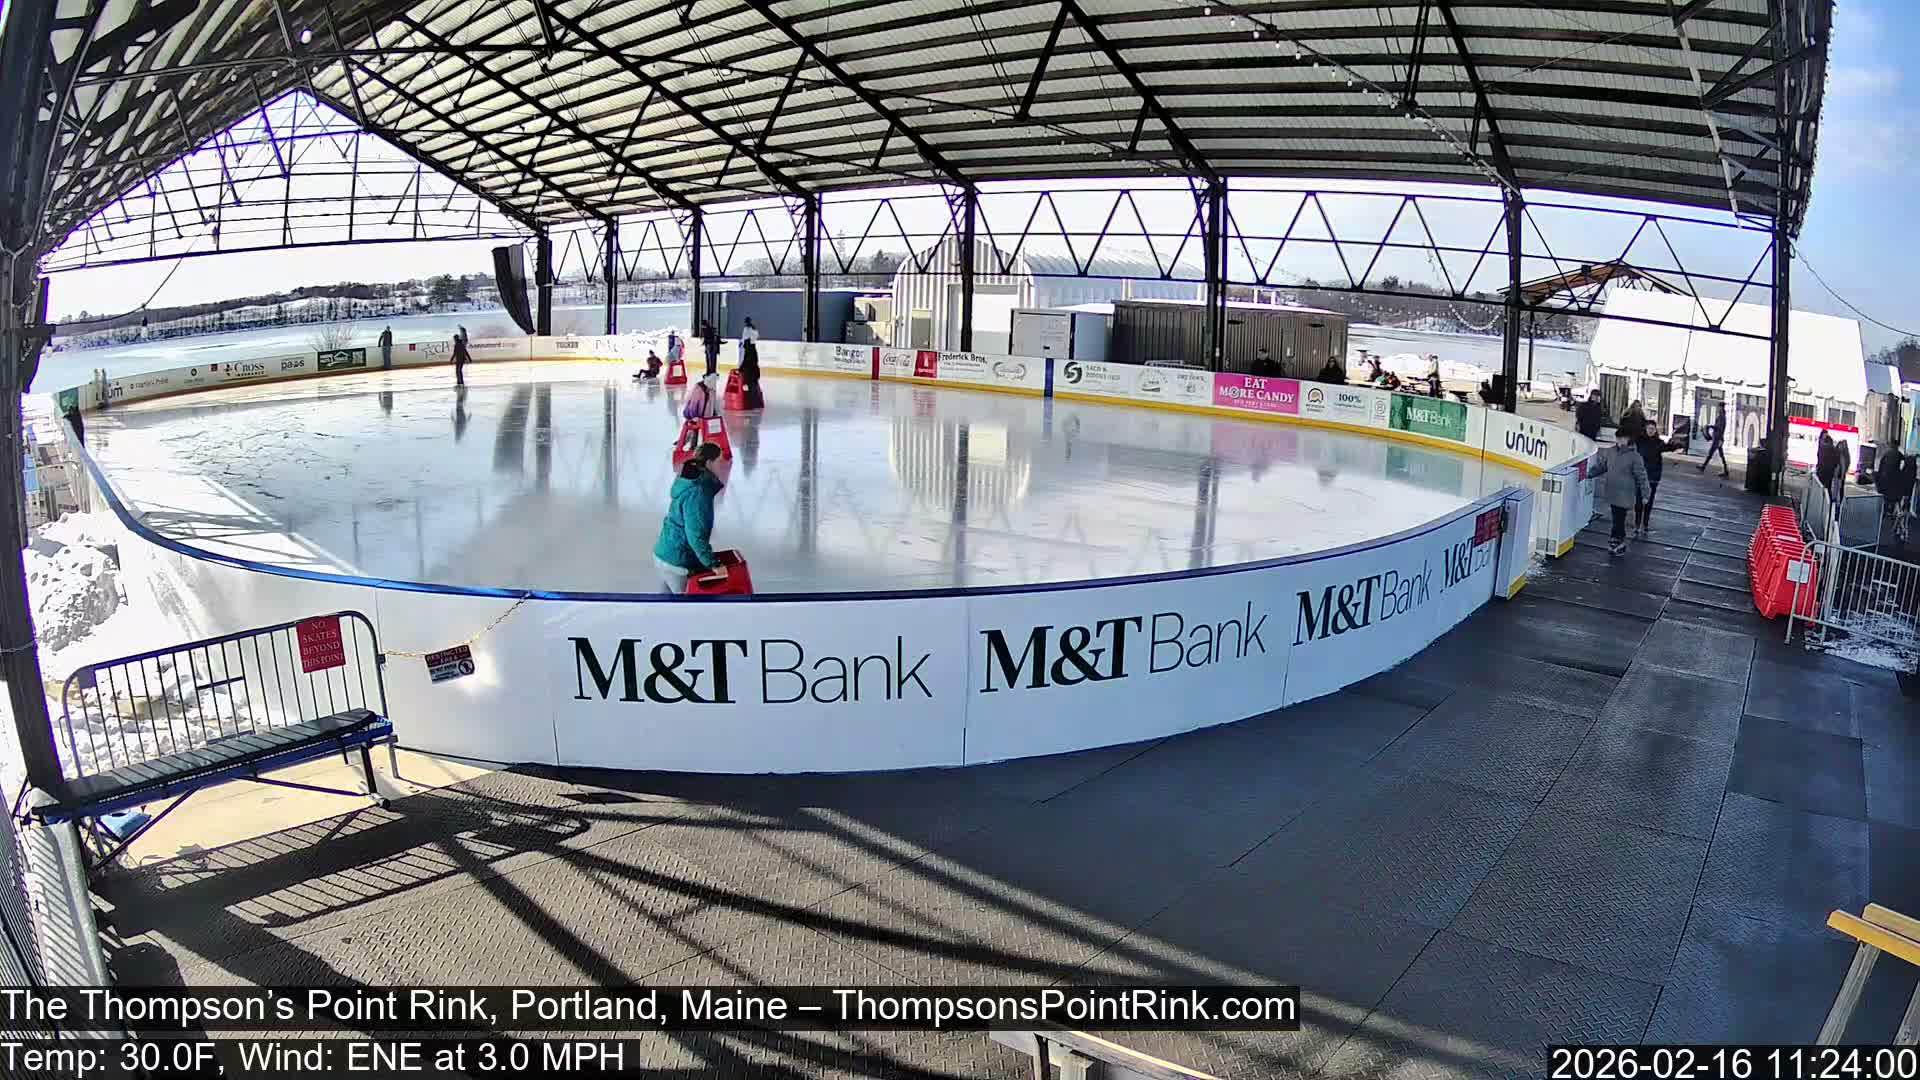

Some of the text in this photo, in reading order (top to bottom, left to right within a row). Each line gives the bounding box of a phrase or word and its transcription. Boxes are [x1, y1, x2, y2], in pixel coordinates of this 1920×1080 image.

[938, 352, 968, 361] Frederick
[1244, 377, 1268, 389] EAT
[1219, 386, 1255, 399] MORE
[1255, 390, 1296, 403] CANDY
[1338, 393, 1361, 402] 100%
[1405, 406, 1453, 427] M&T Bank
[1506, 427, 1548, 460] unum
[1292, 574, 1382, 647] M&T
[1380, 559, 1433, 621] Bank
[311, 620, 326, 631] NO
[303, 630, 337, 644] SKATES
[303, 641, 340, 656] BEYOND
[426, 645, 468, 662] RESTRICTED
[979, 600, 1269, 693] M&T Bank
[303, 653, 344, 669] THIS POINT
[567, 635, 933, 704] M&T Bank
